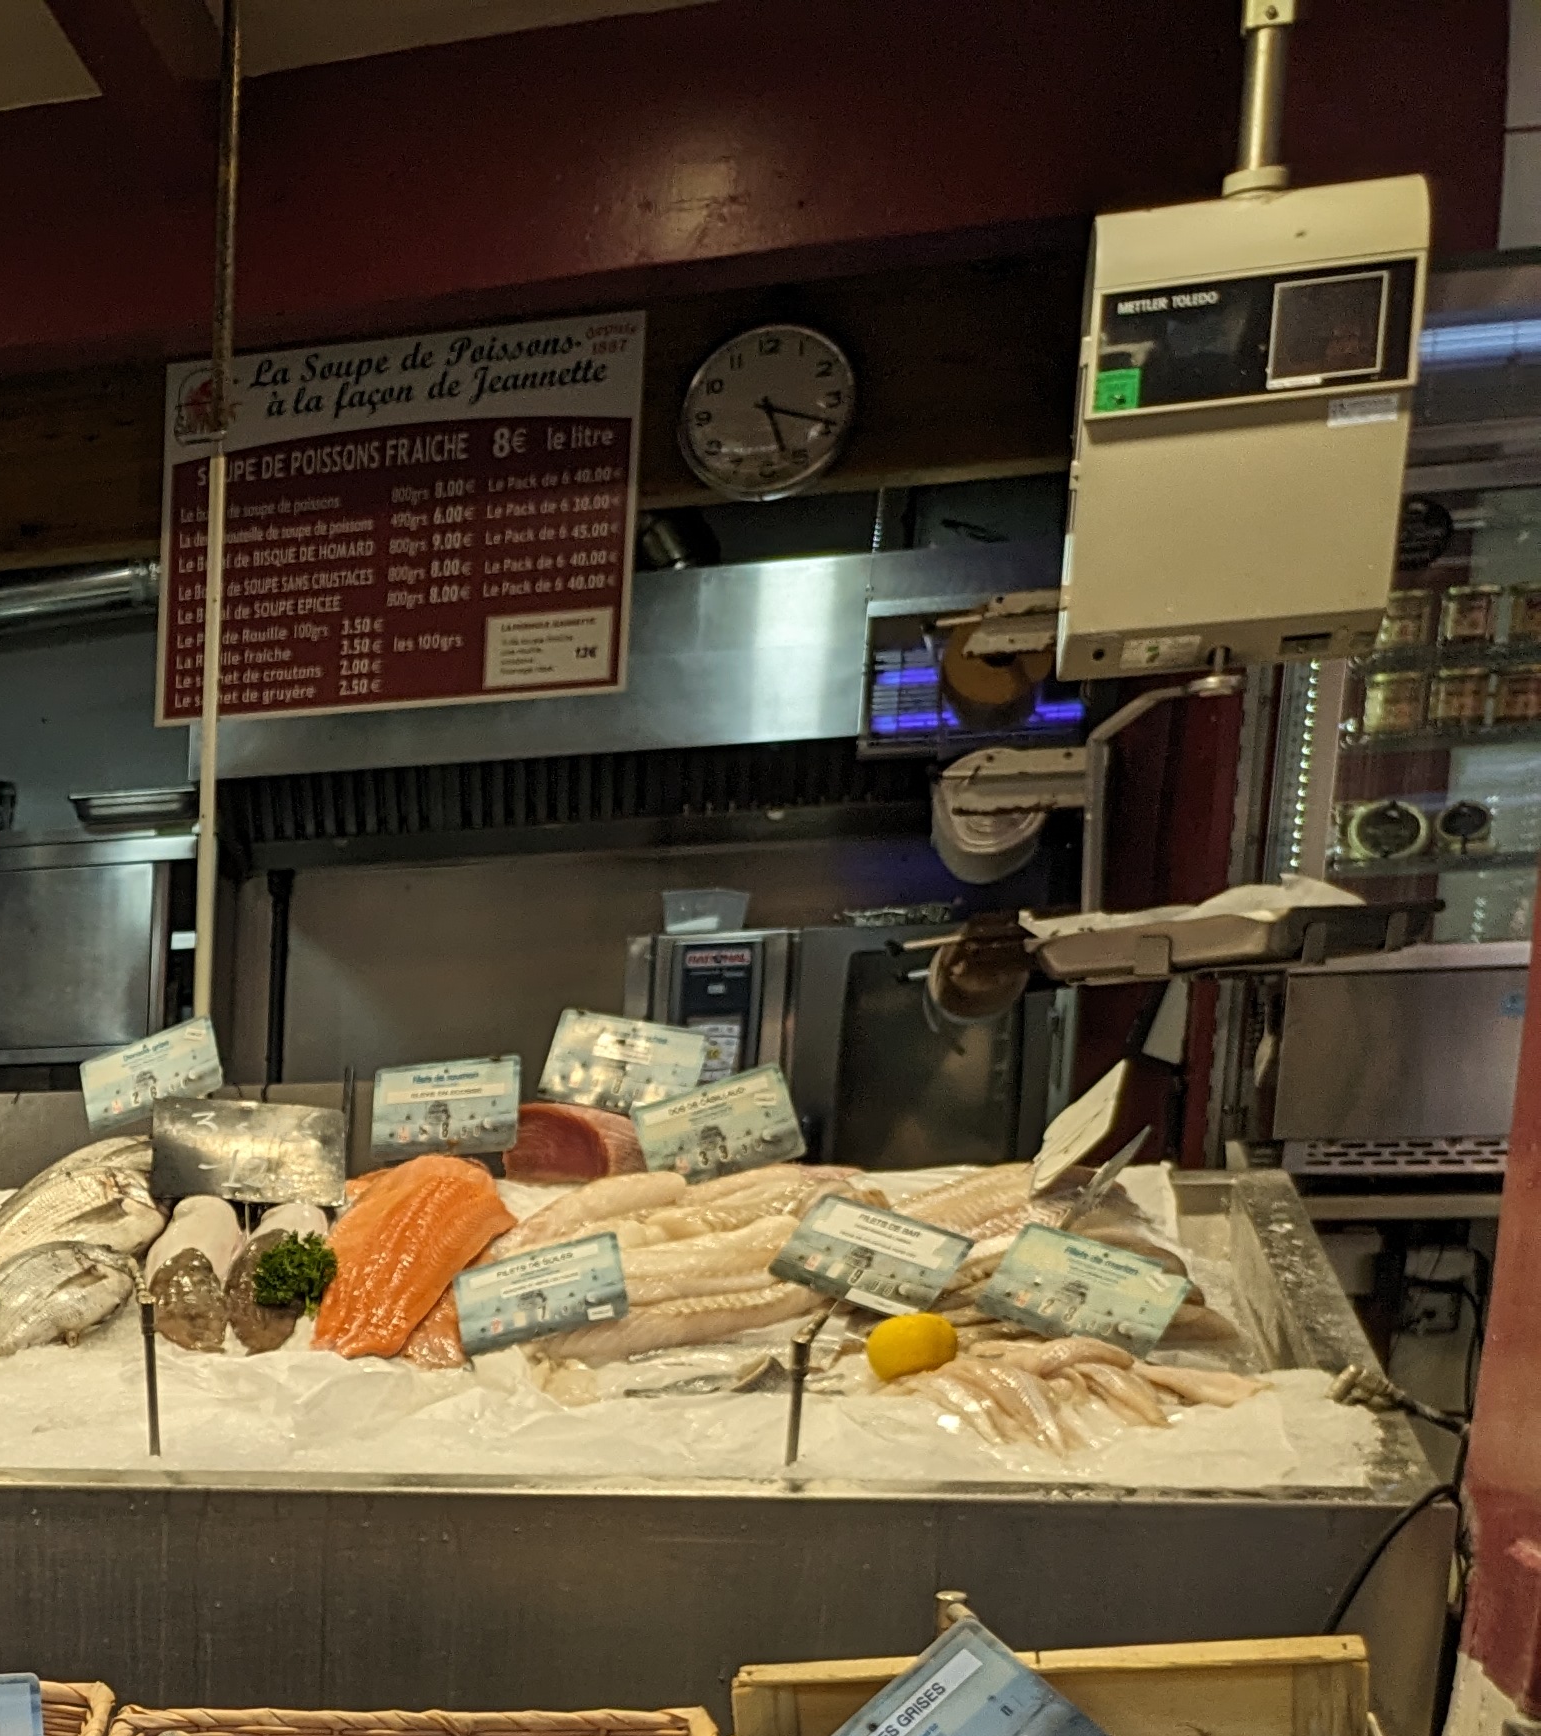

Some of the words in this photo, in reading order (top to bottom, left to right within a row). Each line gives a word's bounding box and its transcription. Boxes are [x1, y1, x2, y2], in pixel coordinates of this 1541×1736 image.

[1117, 296, 1169, 315] METTLER
[1171, 290, 1218, 309] TOLEDO
[250, 359, 291, 388] La
[300, 353, 391, 385] Soupe
[401, 342, 434, 372] de
[267, 391, 286, 417] à
[294, 386, 324, 415] la
[334, 381, 413, 420] façon
[428, 371, 461, 400] de
[469, 358, 607, 405] Jeannette
[261, 453, 286, 478] DE
[291, 440, 381, 477] POISSONS
[385, 432, 469, 467] FRAICHE
[319, 540, 374, 559] HOMARD
[242, 625, 288, 643] Rouille
[896, 1681, 947, 1728] GRISES
